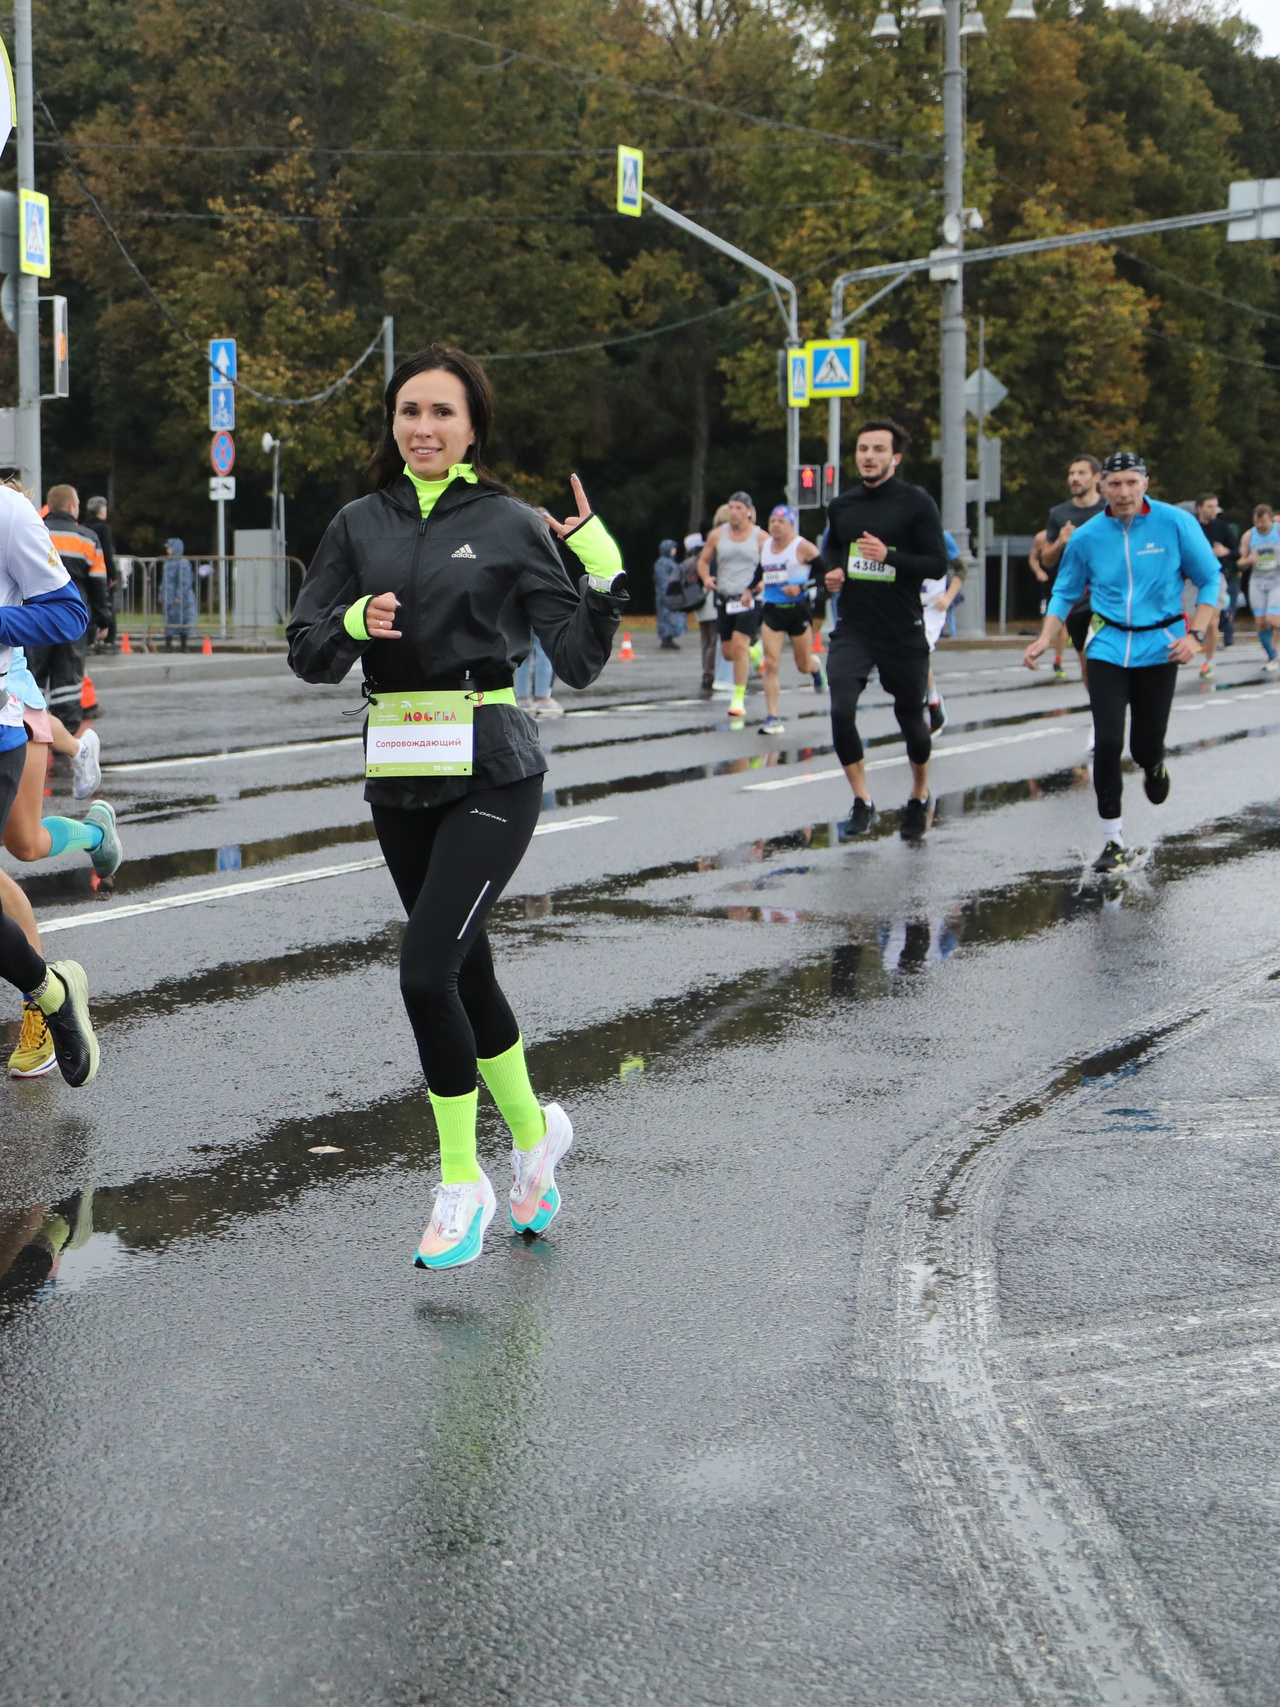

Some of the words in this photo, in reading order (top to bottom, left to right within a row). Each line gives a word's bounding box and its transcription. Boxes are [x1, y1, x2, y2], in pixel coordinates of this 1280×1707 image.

[451, 552, 477, 560] adidas
[403, 711, 457, 722] МОСКВА
[375, 738, 462, 749] Сопровождающий
[479, 811, 508, 823] DEMIX
